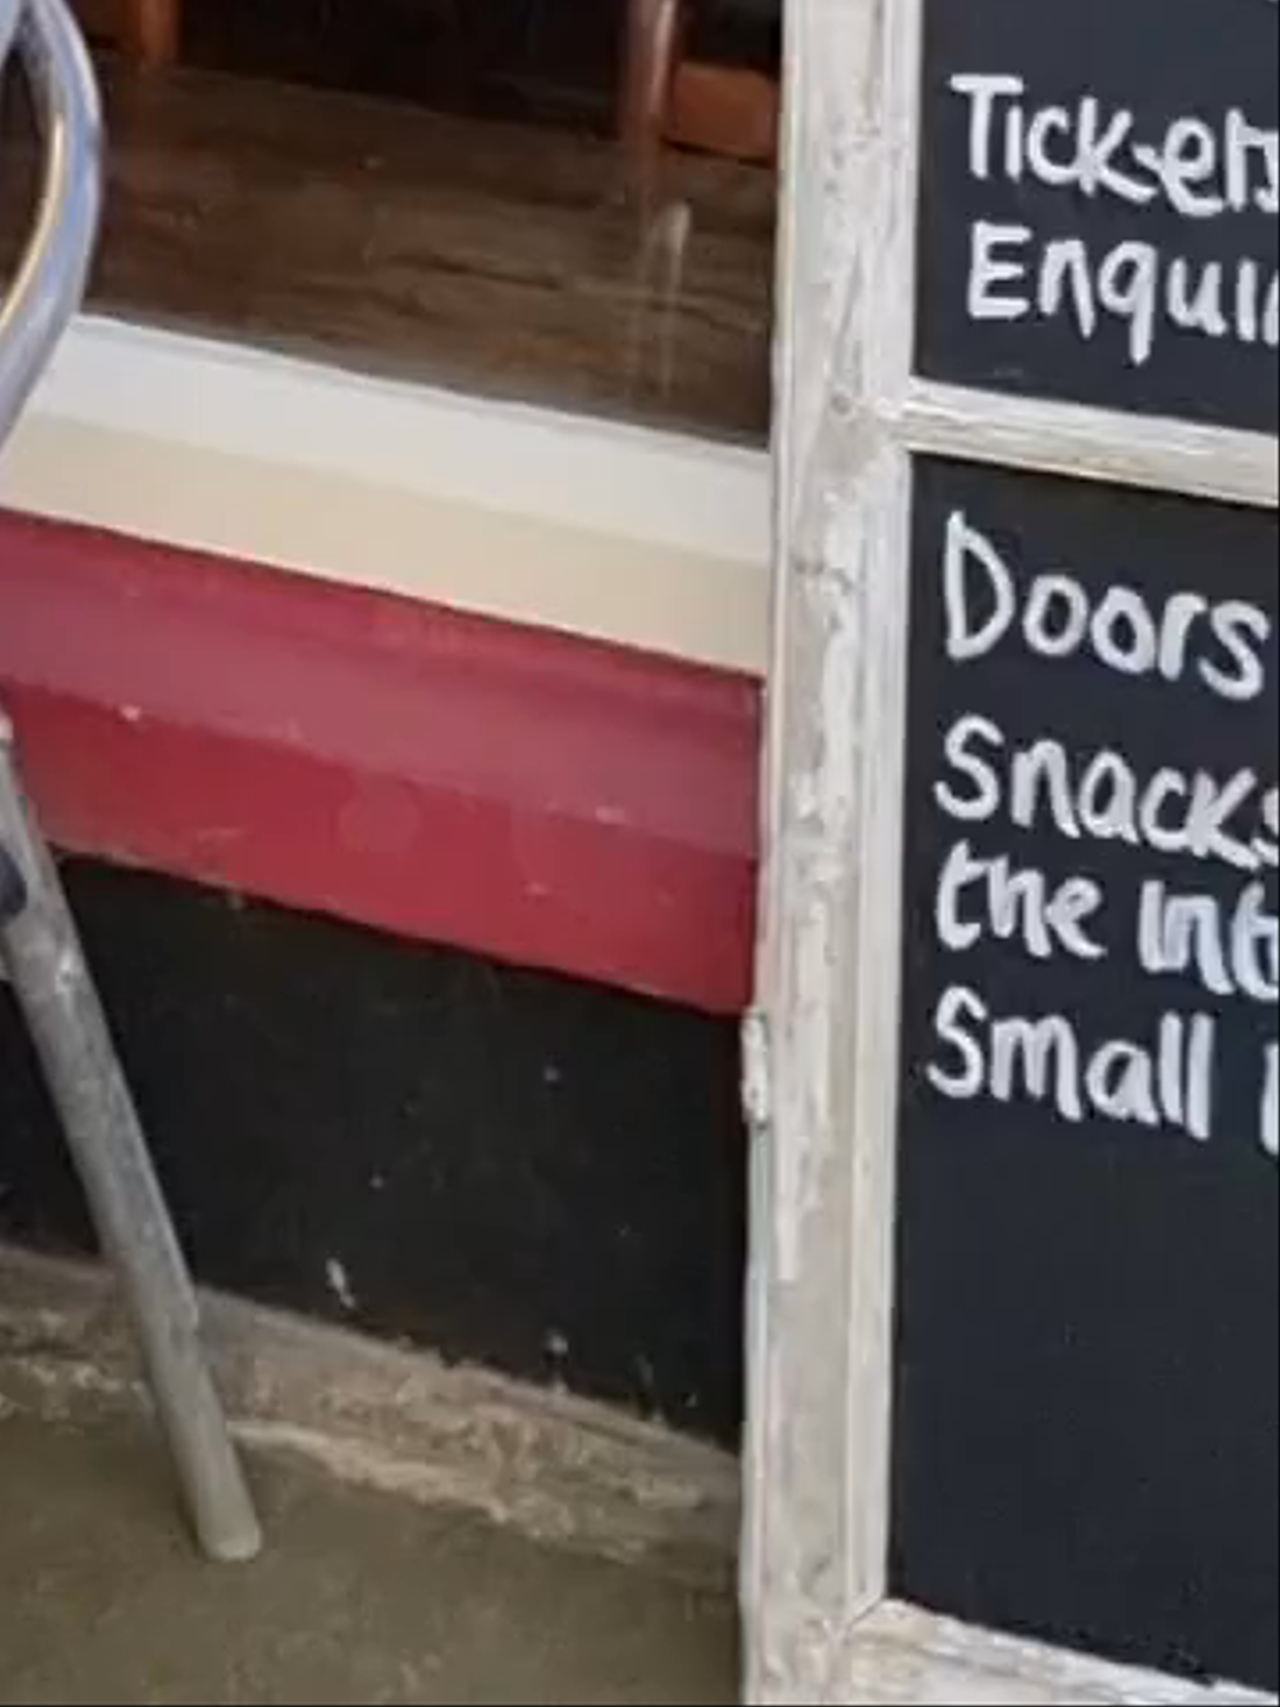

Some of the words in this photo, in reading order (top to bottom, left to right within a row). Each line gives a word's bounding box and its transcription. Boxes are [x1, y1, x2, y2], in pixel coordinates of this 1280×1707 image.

[943, 509, 1271, 700] Doors
[935, 840, 1105, 958] the
[926, 985, 1213, 1140] Small
